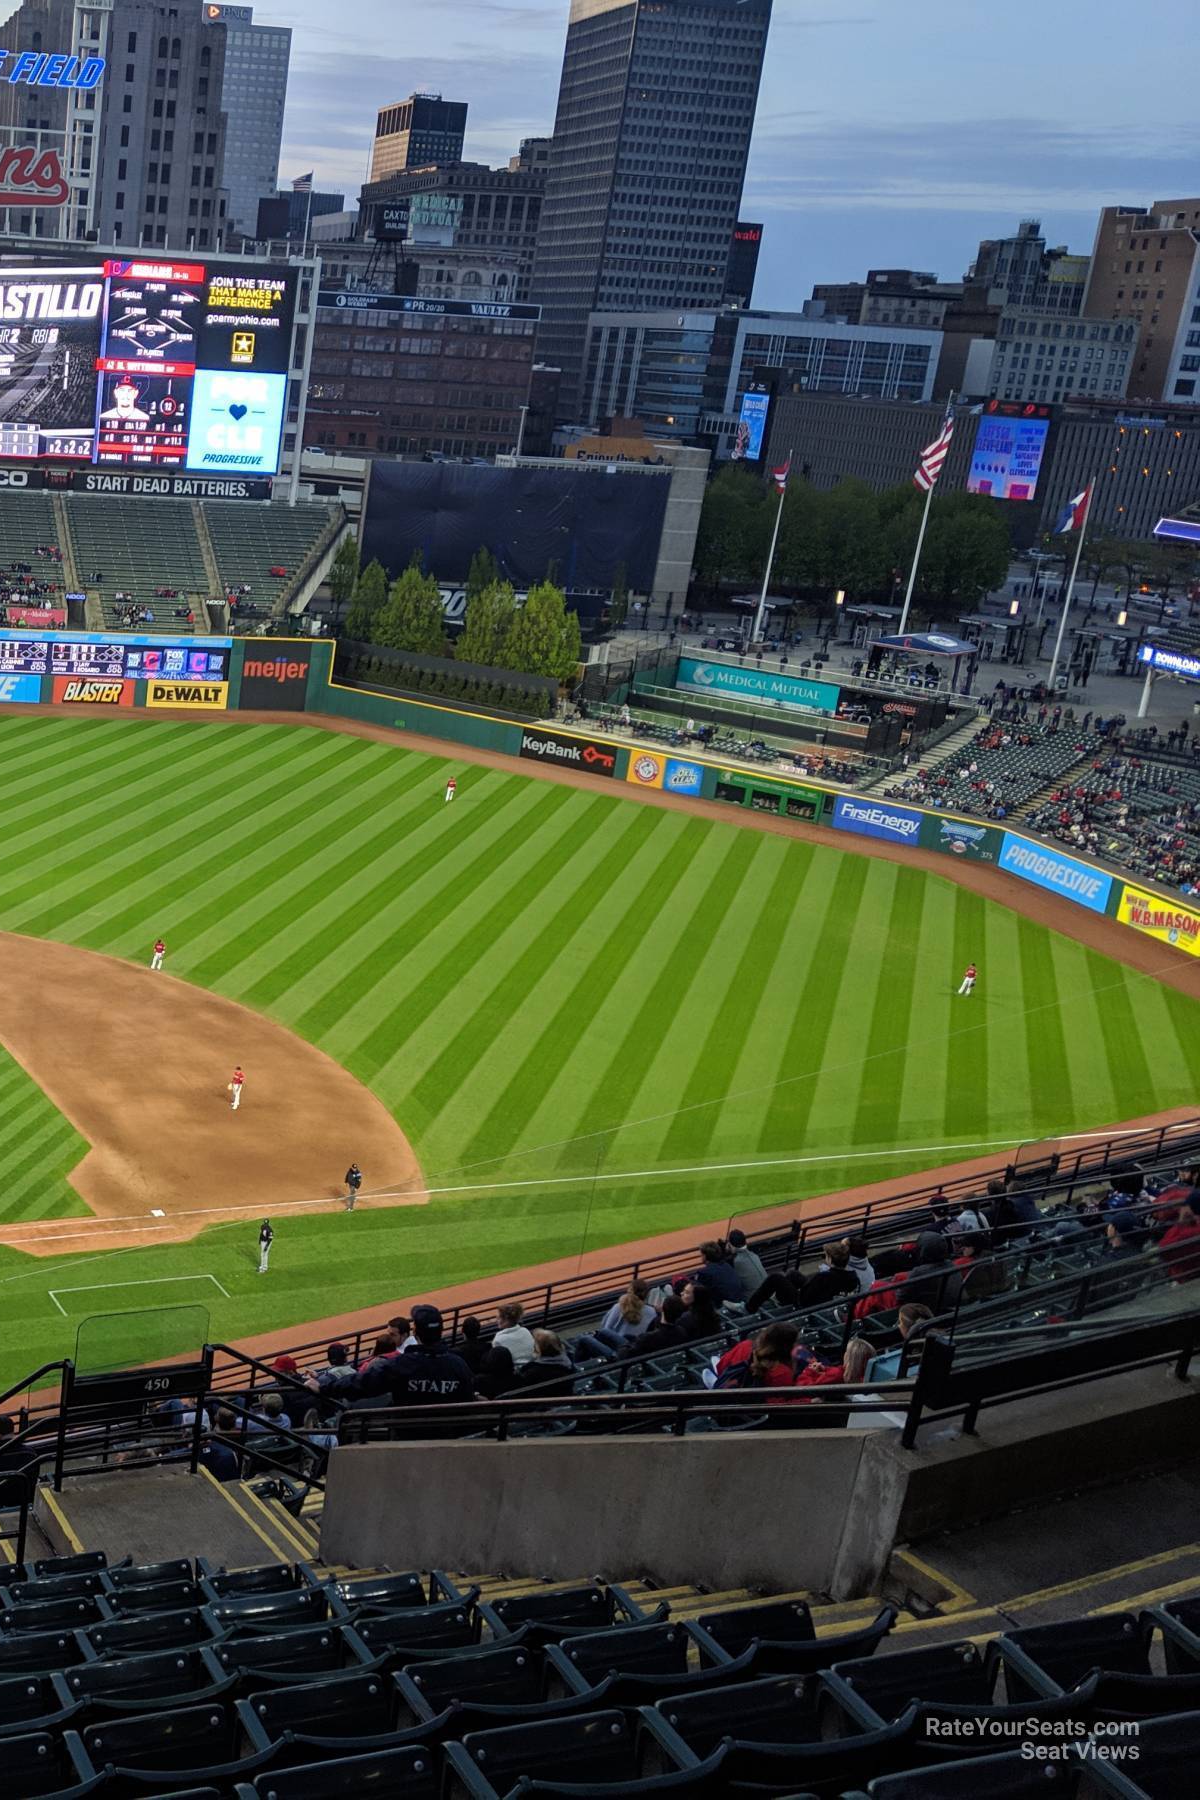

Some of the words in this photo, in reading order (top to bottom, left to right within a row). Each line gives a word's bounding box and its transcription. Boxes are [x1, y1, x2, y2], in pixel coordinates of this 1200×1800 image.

[221, 6, 249, 21] PNC
[9, 52, 106, 89] FIELD
[410, 211, 460, 227] MUTUAL
[734, 229, 760, 242] wald
[210, 276, 234, 288] JOIN
[235, 278, 256, 289] THE
[257, 279, 285, 291] TEAM
[209, 287, 235, 298] THAT
[237, 288, 272, 299] MAKES
[272, 290, 282, 300] A
[208, 296, 273, 309] DIFFERENCE.
[412, 301, 425, 311] PR
[425, 303, 445, 313] 20/20
[471, 303, 512, 317] VAULTZ
[205, 313, 279, 327] goarmyohio.com
[9, 329, 21, 344] 2
[31, 329, 49, 344] RBI
[54, 440, 61, 454] 2
[68, 440, 75, 454] 2
[83, 441, 90, 455] 2
[202, 453, 263, 466] PROGRESSIVE
[86, 475, 130, 491] START
[133, 477, 170, 494] DEAD
[174, 479, 249, 497] BATTERIES.
[167, 650, 184, 659] FOX
[166, 662, 182, 671] GO
[192, 653, 206, 672] C
[243, 656, 309, 684] meijer
[717, 671, 770, 691] MEDICAL
[771, 681, 820, 700] MUTUAL
[522, 735, 581, 761] KeyBank
[670, 773, 697, 785] CLEAN
[841, 803, 920, 837] FirstEnergy
[1005, 843, 1103, 899] PROGRESSIVE
[144, 1377, 170, 1391] 450
[406, 1376, 460, 1397] STAFF
